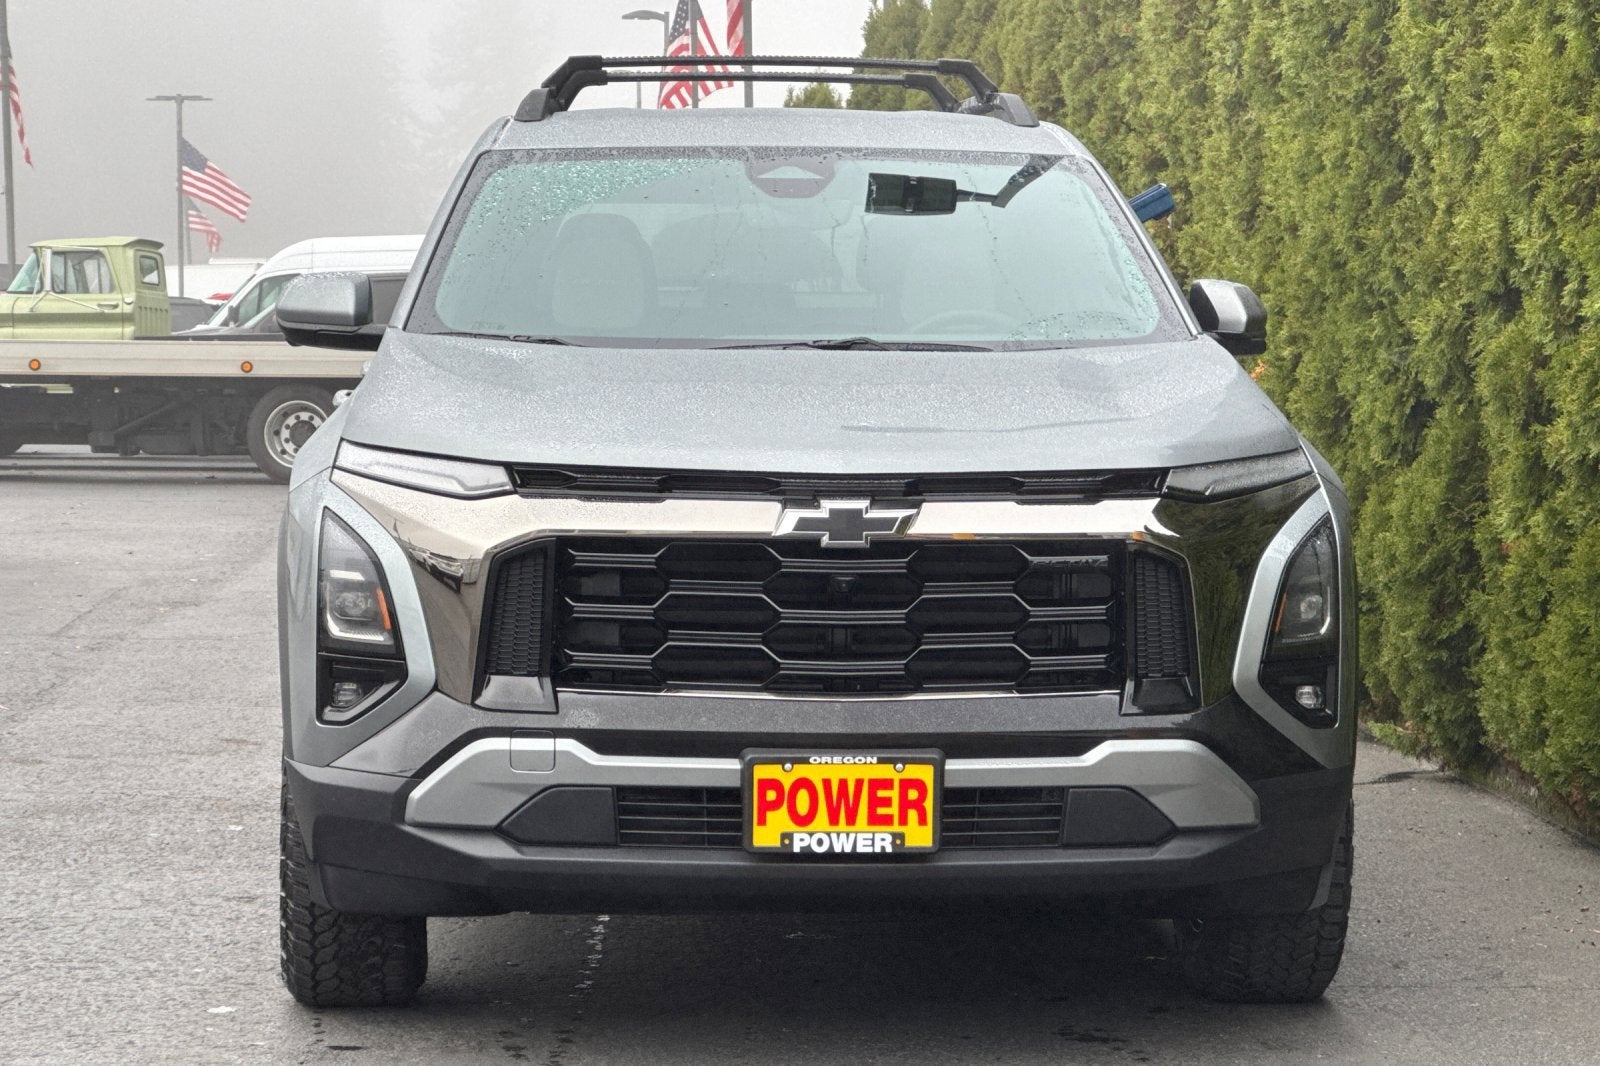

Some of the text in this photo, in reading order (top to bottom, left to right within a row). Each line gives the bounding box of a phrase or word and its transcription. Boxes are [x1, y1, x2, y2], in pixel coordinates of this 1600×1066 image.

[809, 756, 878, 764] OREGON
[756, 777, 928, 827] POWER
[793, 832, 893, 853] POWER
